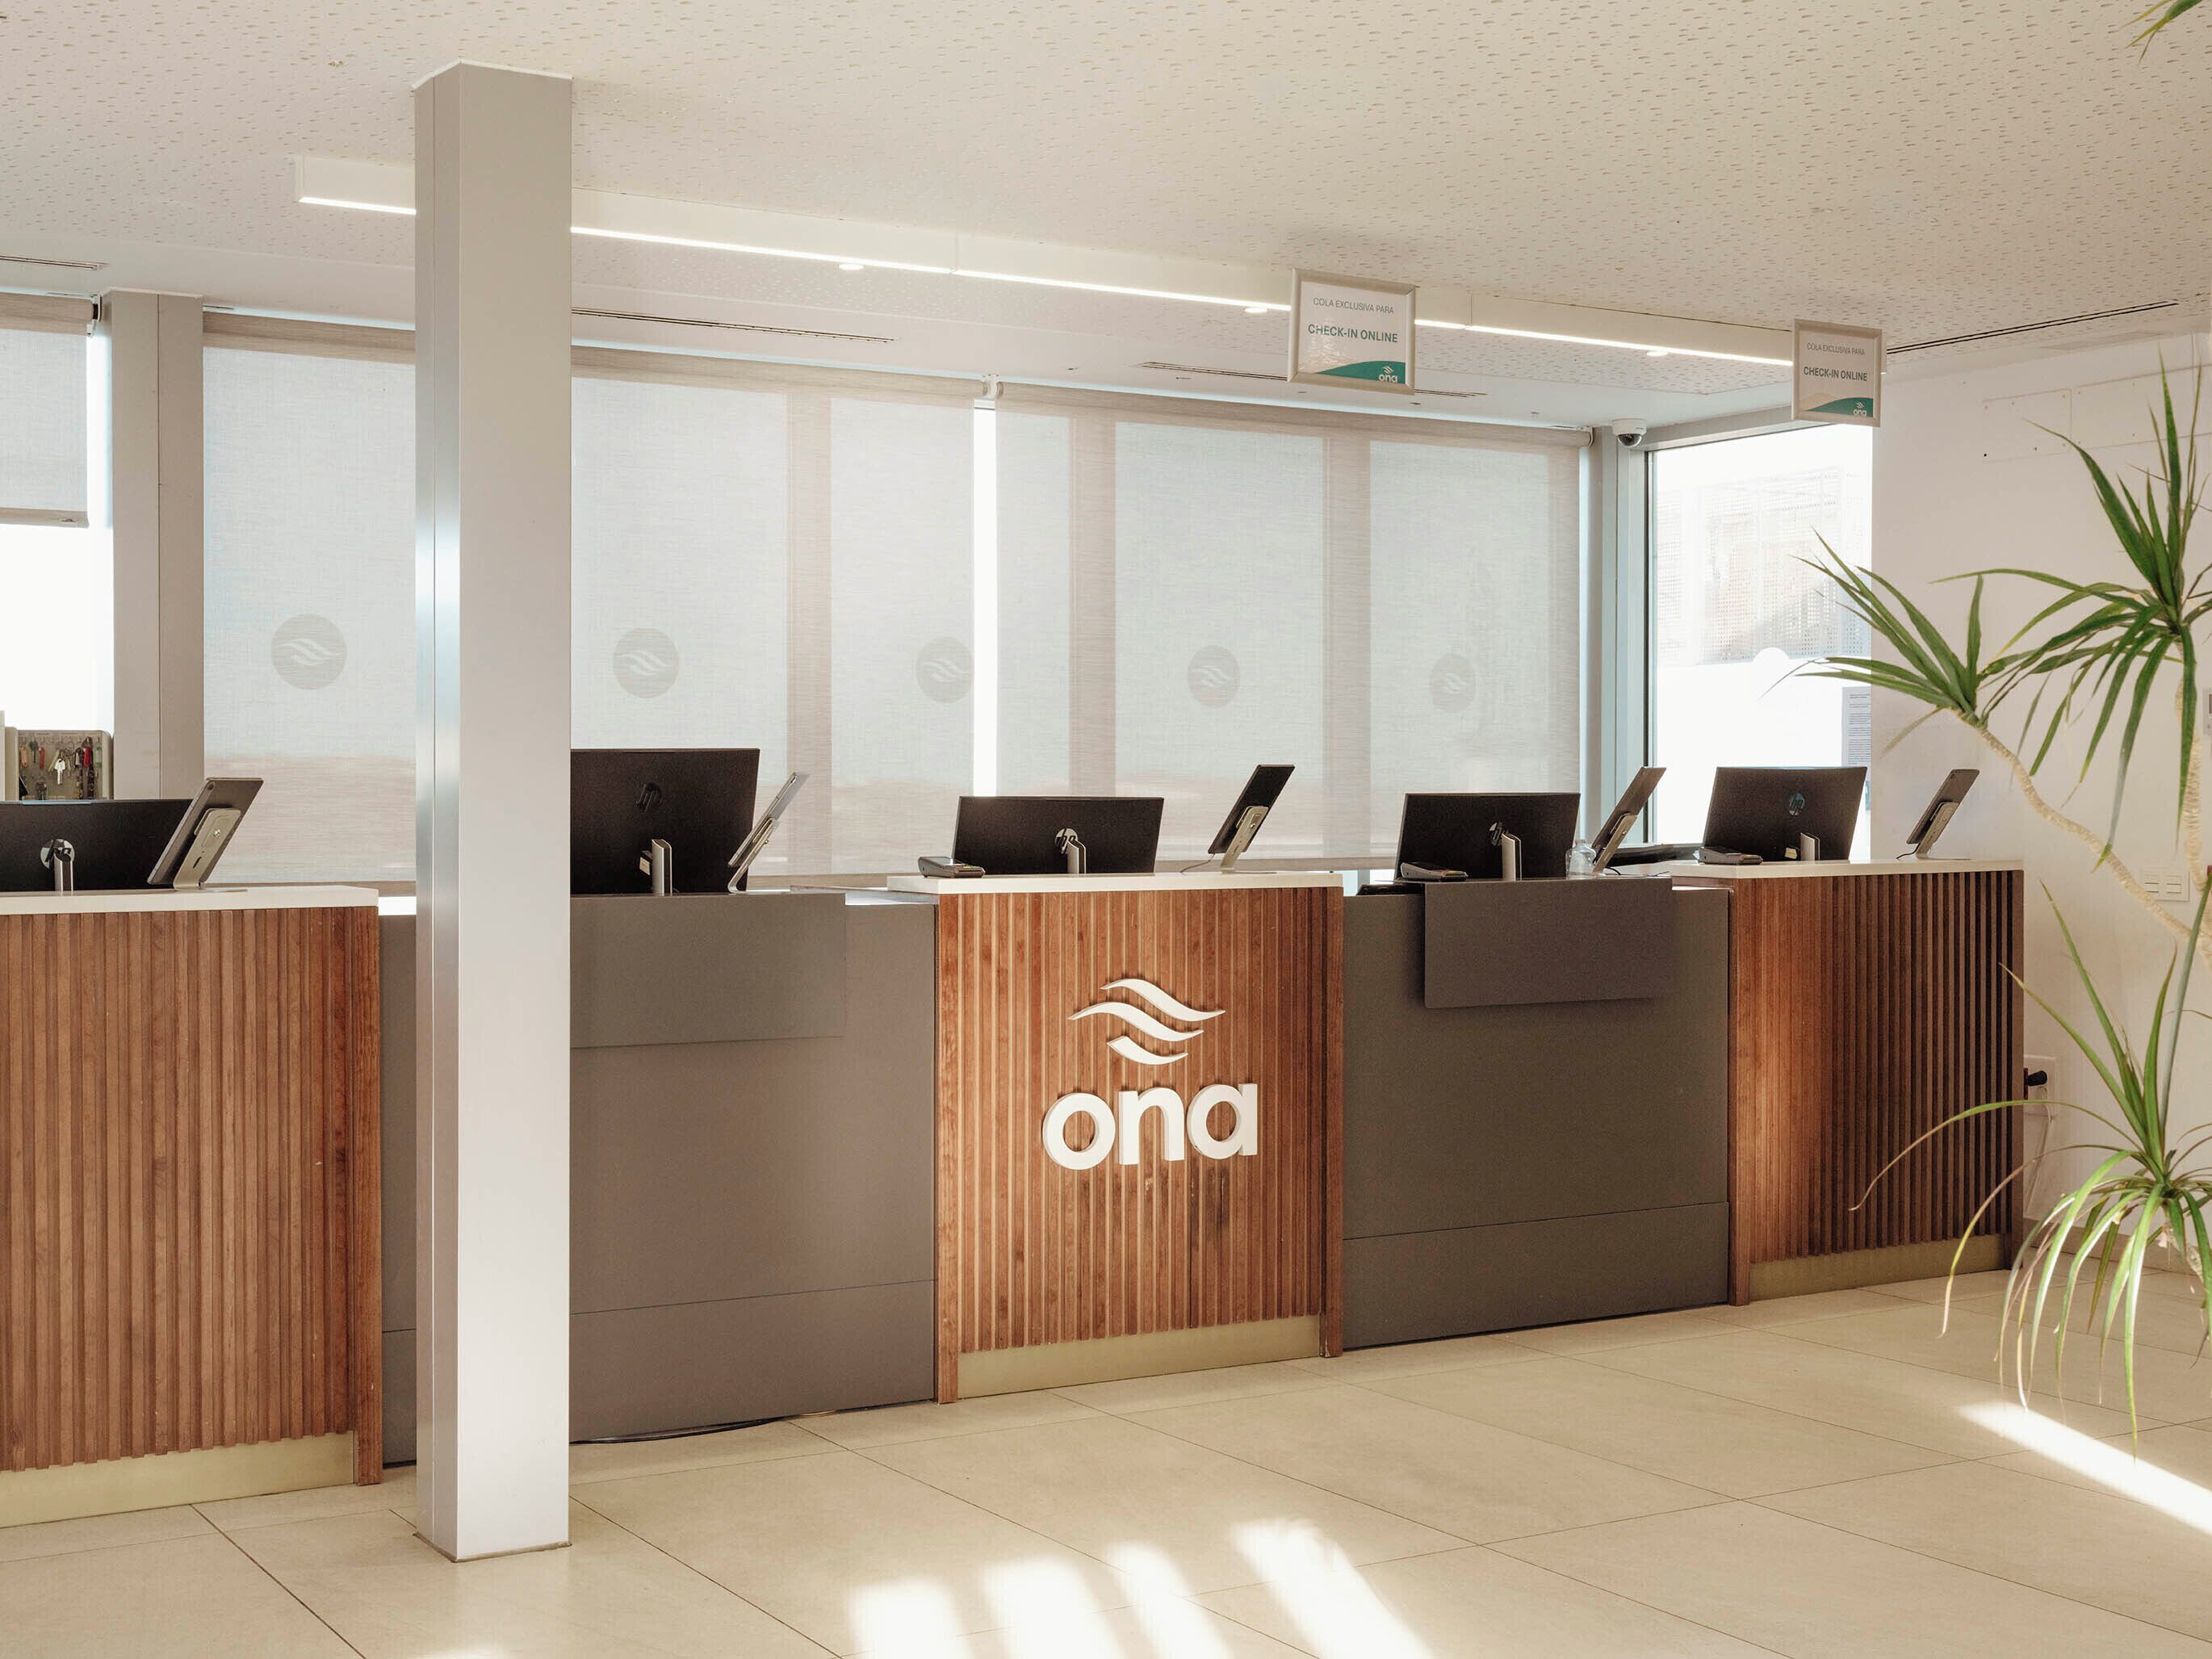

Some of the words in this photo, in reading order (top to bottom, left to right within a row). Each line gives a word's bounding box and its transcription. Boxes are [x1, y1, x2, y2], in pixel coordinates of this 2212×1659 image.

[1313, 297, 1334, 307] COLA
[1335, 300, 1374, 312] EXCLUSIVA
[1376, 304, 1394, 314] PARA
[1308, 324, 1358, 339] CHECK-IN
[1360, 329, 1398, 343] ONLINE
[1807, 343, 1822, 351] COLA
[1823, 344, 1851, 354] EXCLUSIVA
[1852, 347, 1865, 355] PARA
[1378, 373, 1398, 383] ona
[1804, 367, 1839, 379] CHECK-IN
[1841, 370, 1867, 381] ONLINE
[1042, 1083, 1258, 1170] ona
